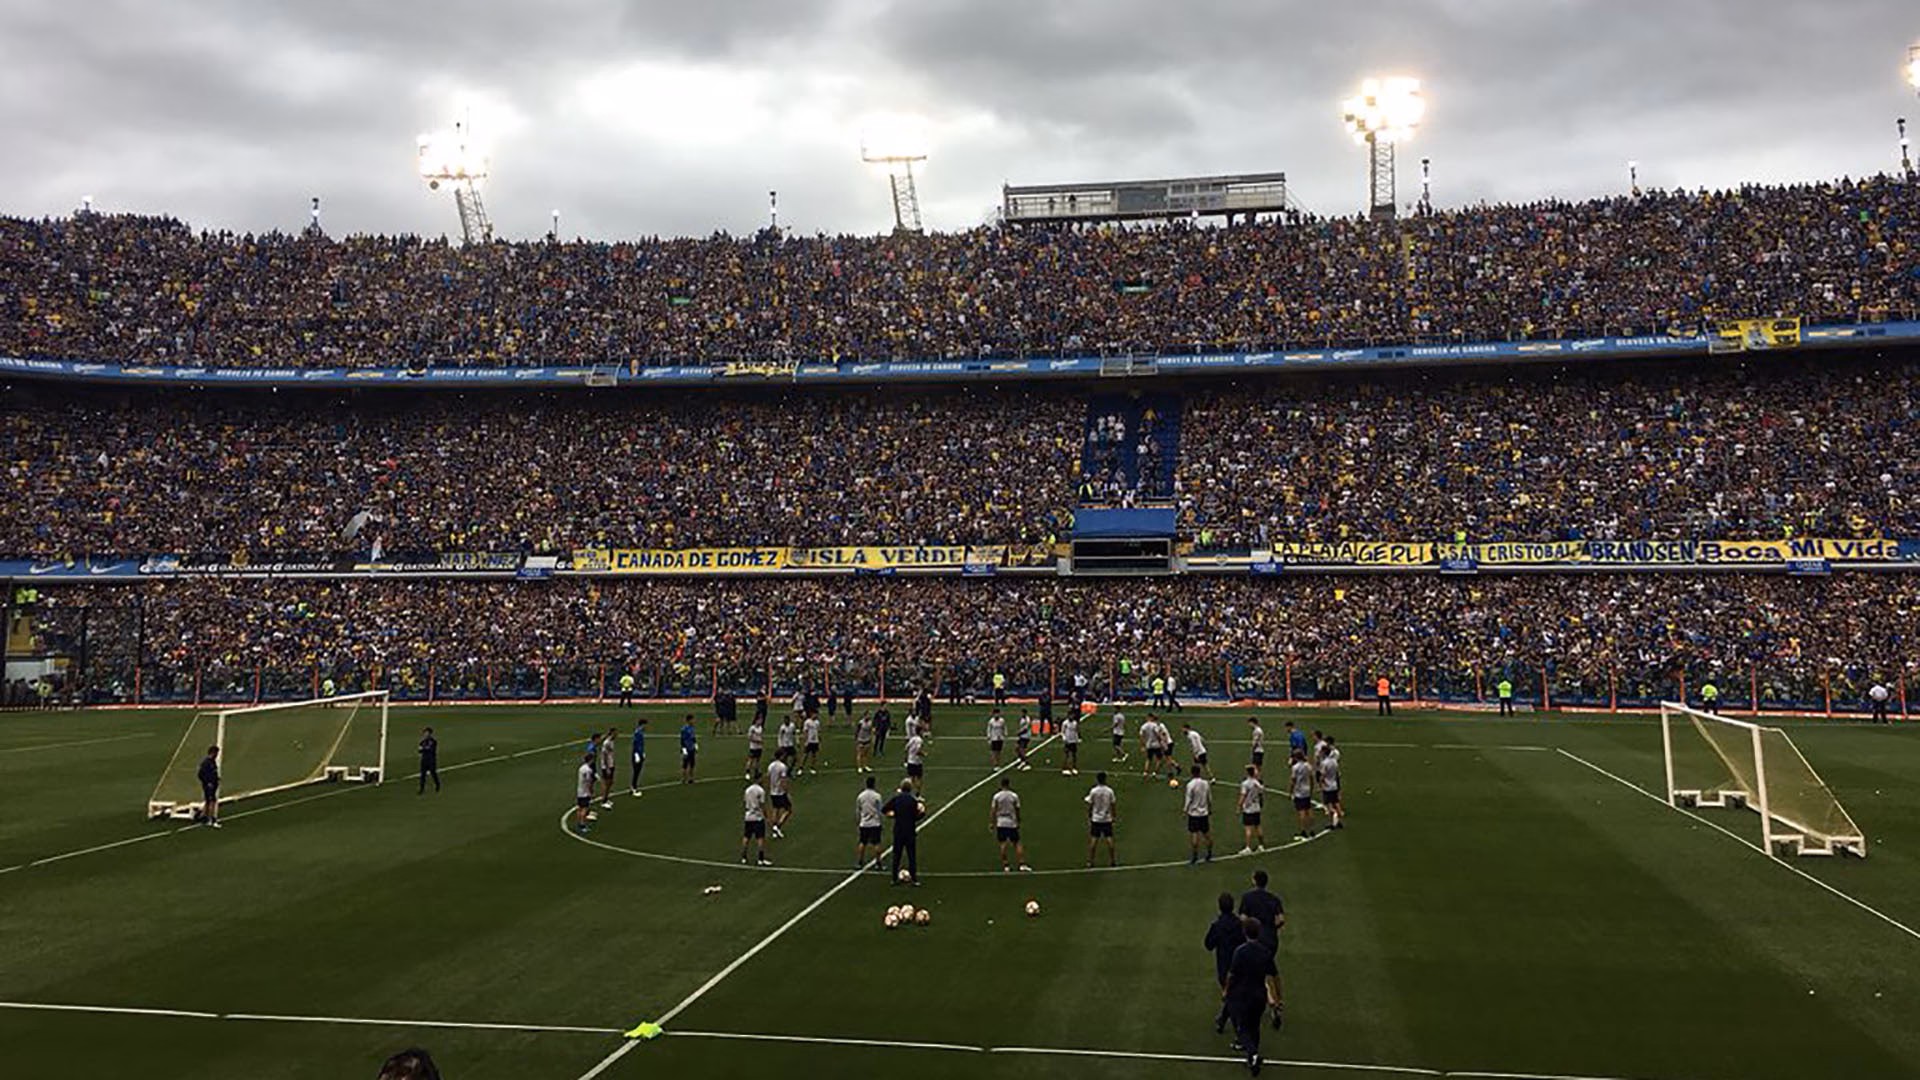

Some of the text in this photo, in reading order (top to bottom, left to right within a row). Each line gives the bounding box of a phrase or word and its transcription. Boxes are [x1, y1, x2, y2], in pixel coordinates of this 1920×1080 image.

[811, 549, 867, 564] ISLA
[880, 548, 962, 564] VERDE
[1358, 544, 1424, 562] GERLI
[1449, 544, 1570, 561] SAN CRISTOBAL
[1590, 540, 1694, 561] BRANDSEN
[1701, 543, 1782, 559] Boca
[1832, 540, 1901, 557] Vida
[688, 552, 714, 567] DE
